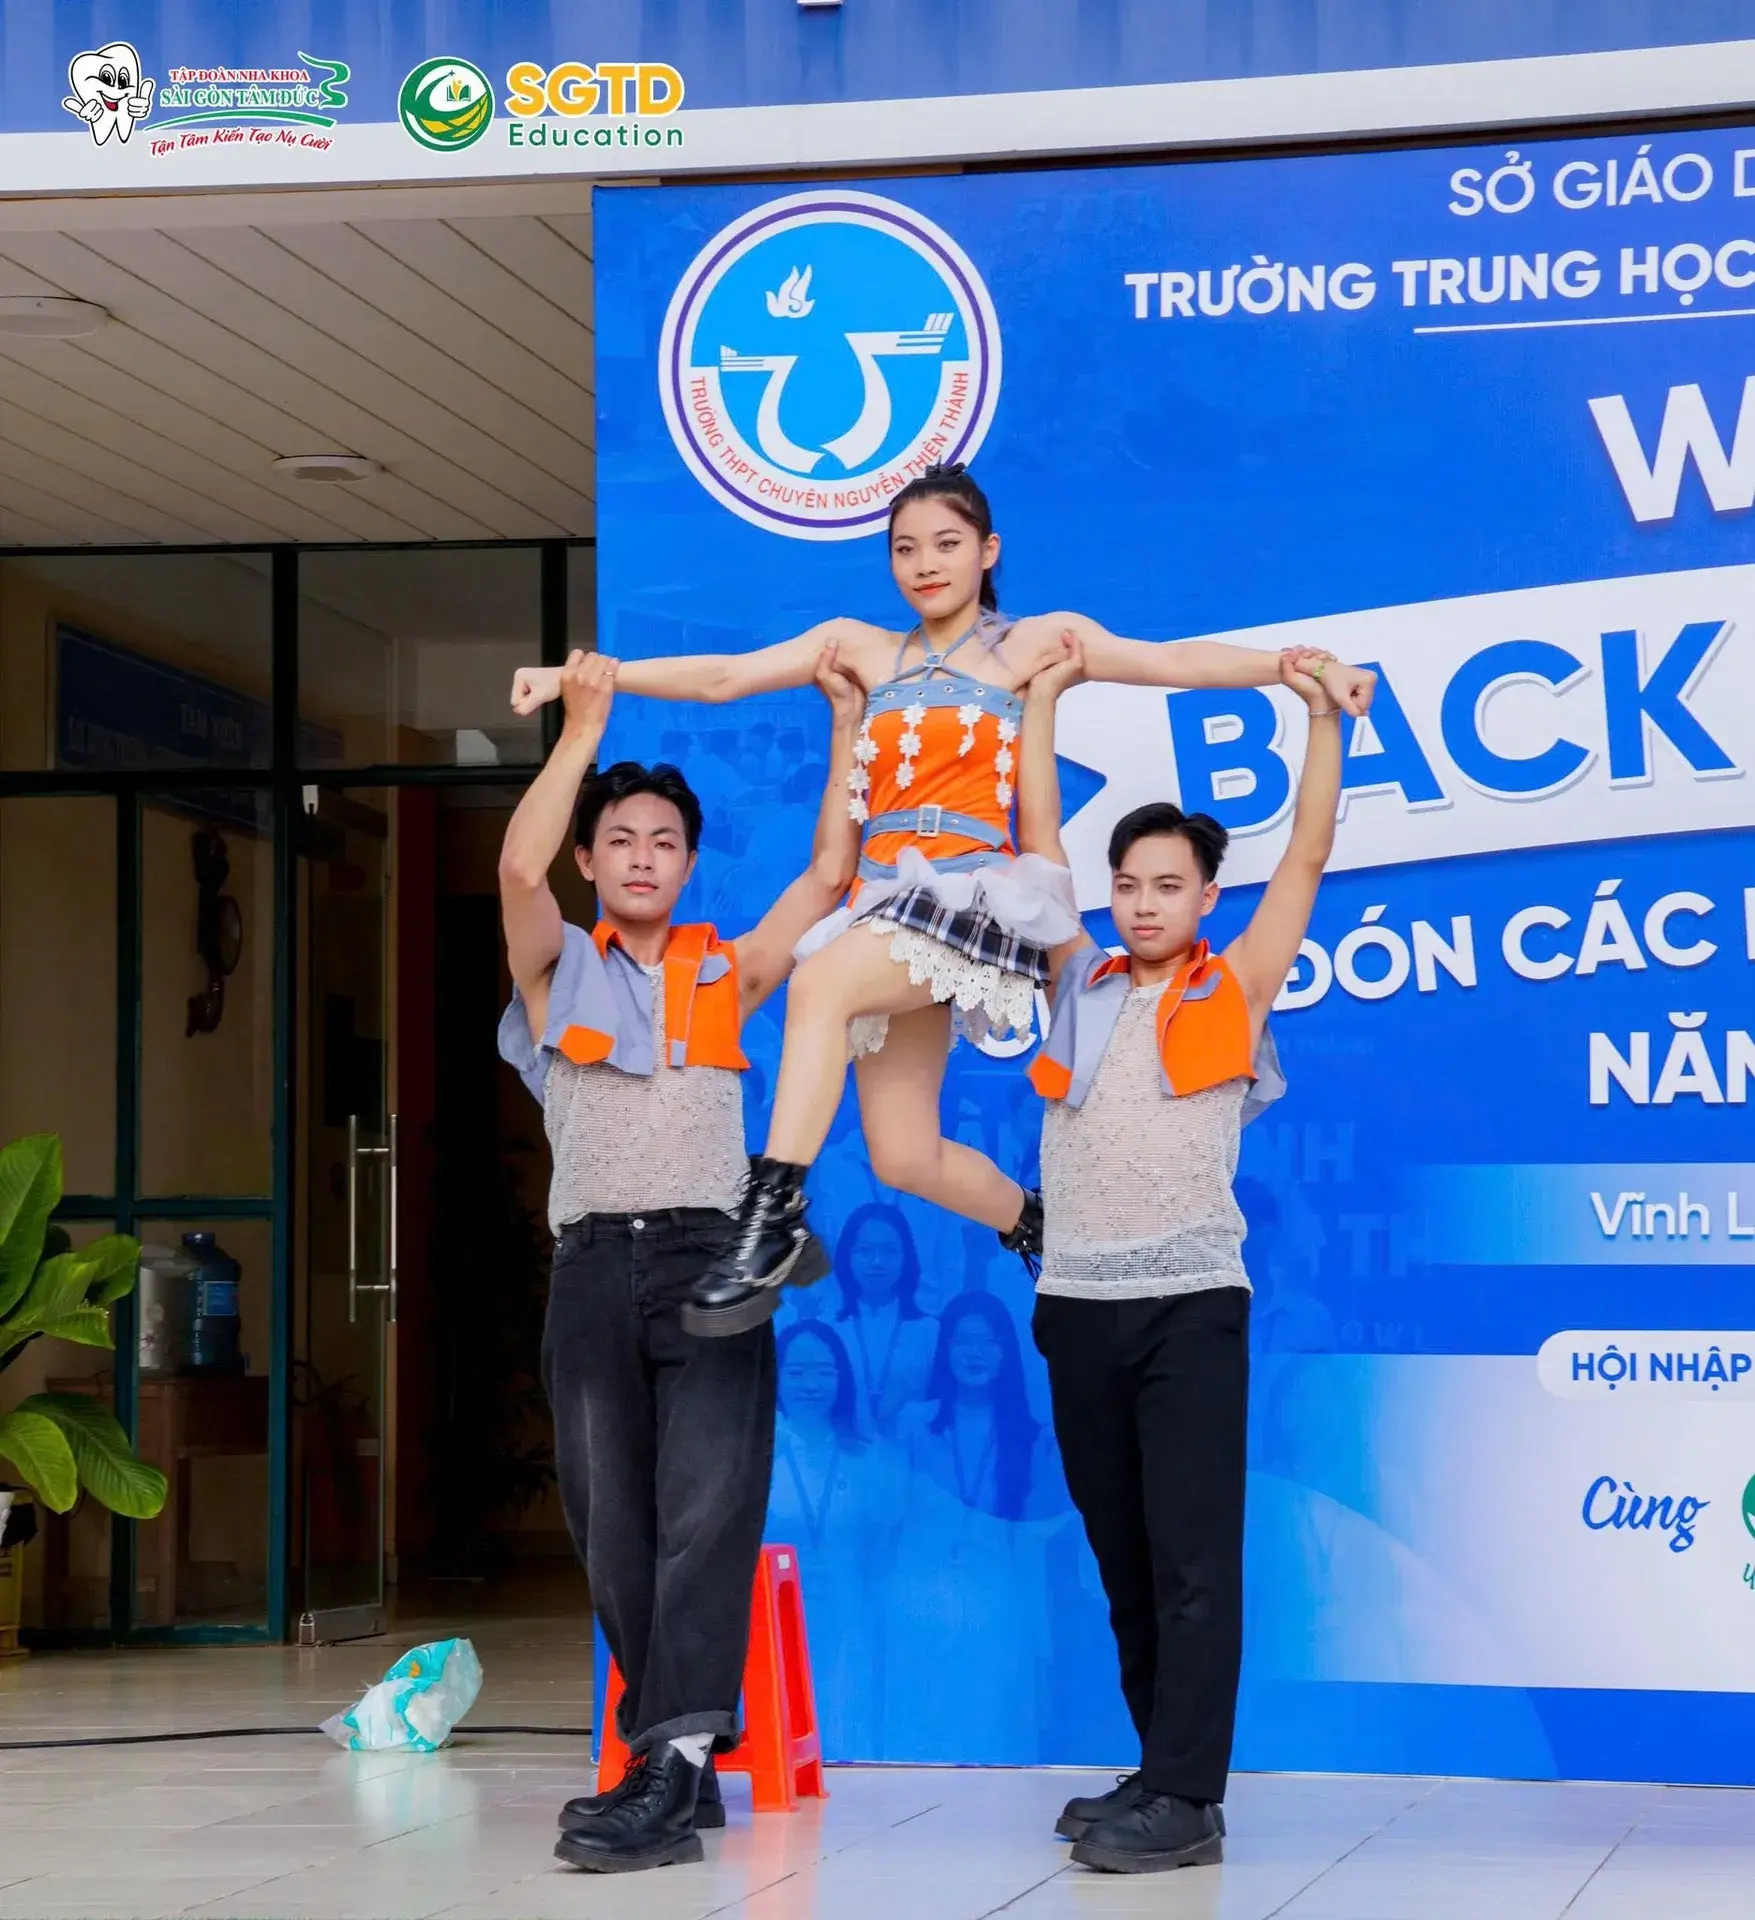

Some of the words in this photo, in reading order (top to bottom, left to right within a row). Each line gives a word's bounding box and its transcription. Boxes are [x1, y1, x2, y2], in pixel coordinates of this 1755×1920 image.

[1448, 151, 1535, 217] SỞ
[1552, 144, 1713, 210] GIÁO
[1125, 254, 1377, 319] TRƯỜNG
[1392, 250, 1600, 307] TRUNG
[1620, 239, 1755, 306] HỌC
[690, 376, 724, 449] TRƯỜNG
[719, 445, 759, 484] THPT
[757, 478, 828, 509] CHUYÊN
[834, 472, 906, 508] NGUYỄN
[1166, 620, 1736, 829] BACK
[1501, 879, 1719, 981] CÁC
[1589, 1192, 1710, 1237] Vĩnh
[1571, 1344, 1637, 1391] HỘI
[1650, 1345, 1752, 1391] NHẬP
[1581, 1475, 1711, 1554] Cùng
